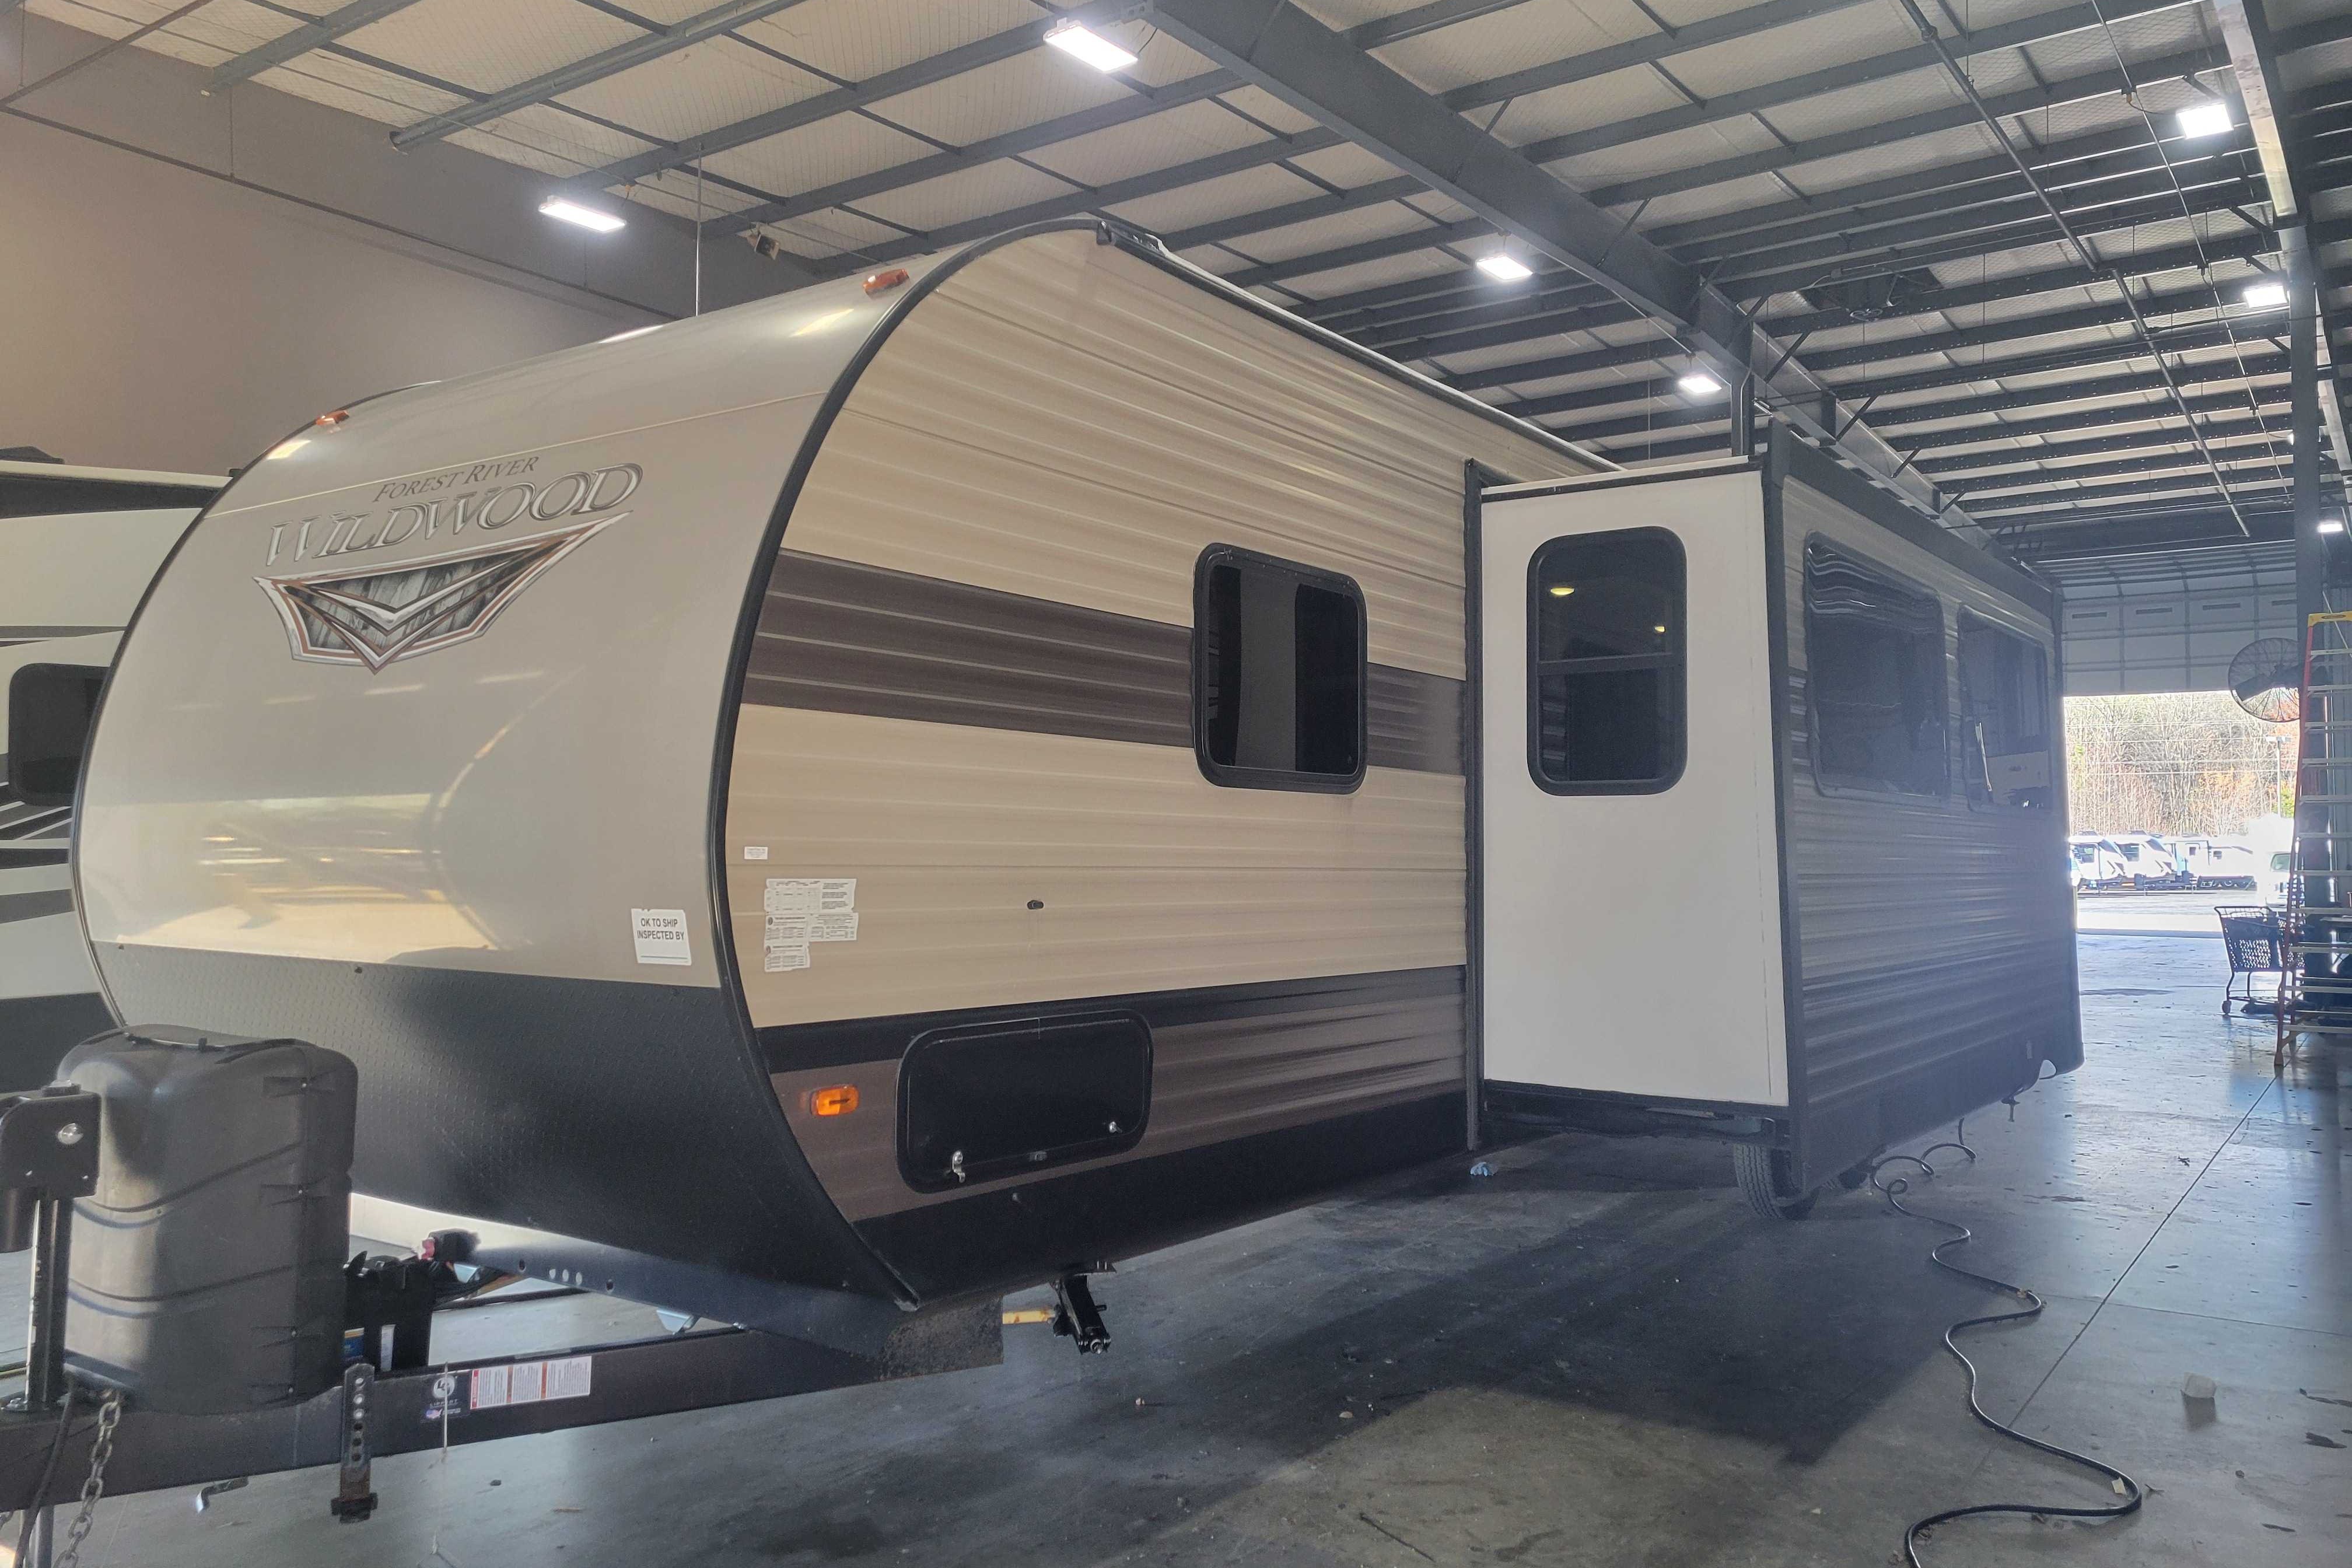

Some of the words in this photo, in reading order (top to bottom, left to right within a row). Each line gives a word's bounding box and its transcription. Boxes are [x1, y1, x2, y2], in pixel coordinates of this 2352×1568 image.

[373, 471, 465, 503] FOREST
[463, 456, 539, 485] RIVER
[266, 463, 643, 566] WILDWOOD
[637, 930, 674, 940] INSPECTED
[676, 931, 684, 940] BY
[640, 918, 651, 927] OK
[652, 918, 661, 928] TO
[663, 918, 678, 928] SHIP
